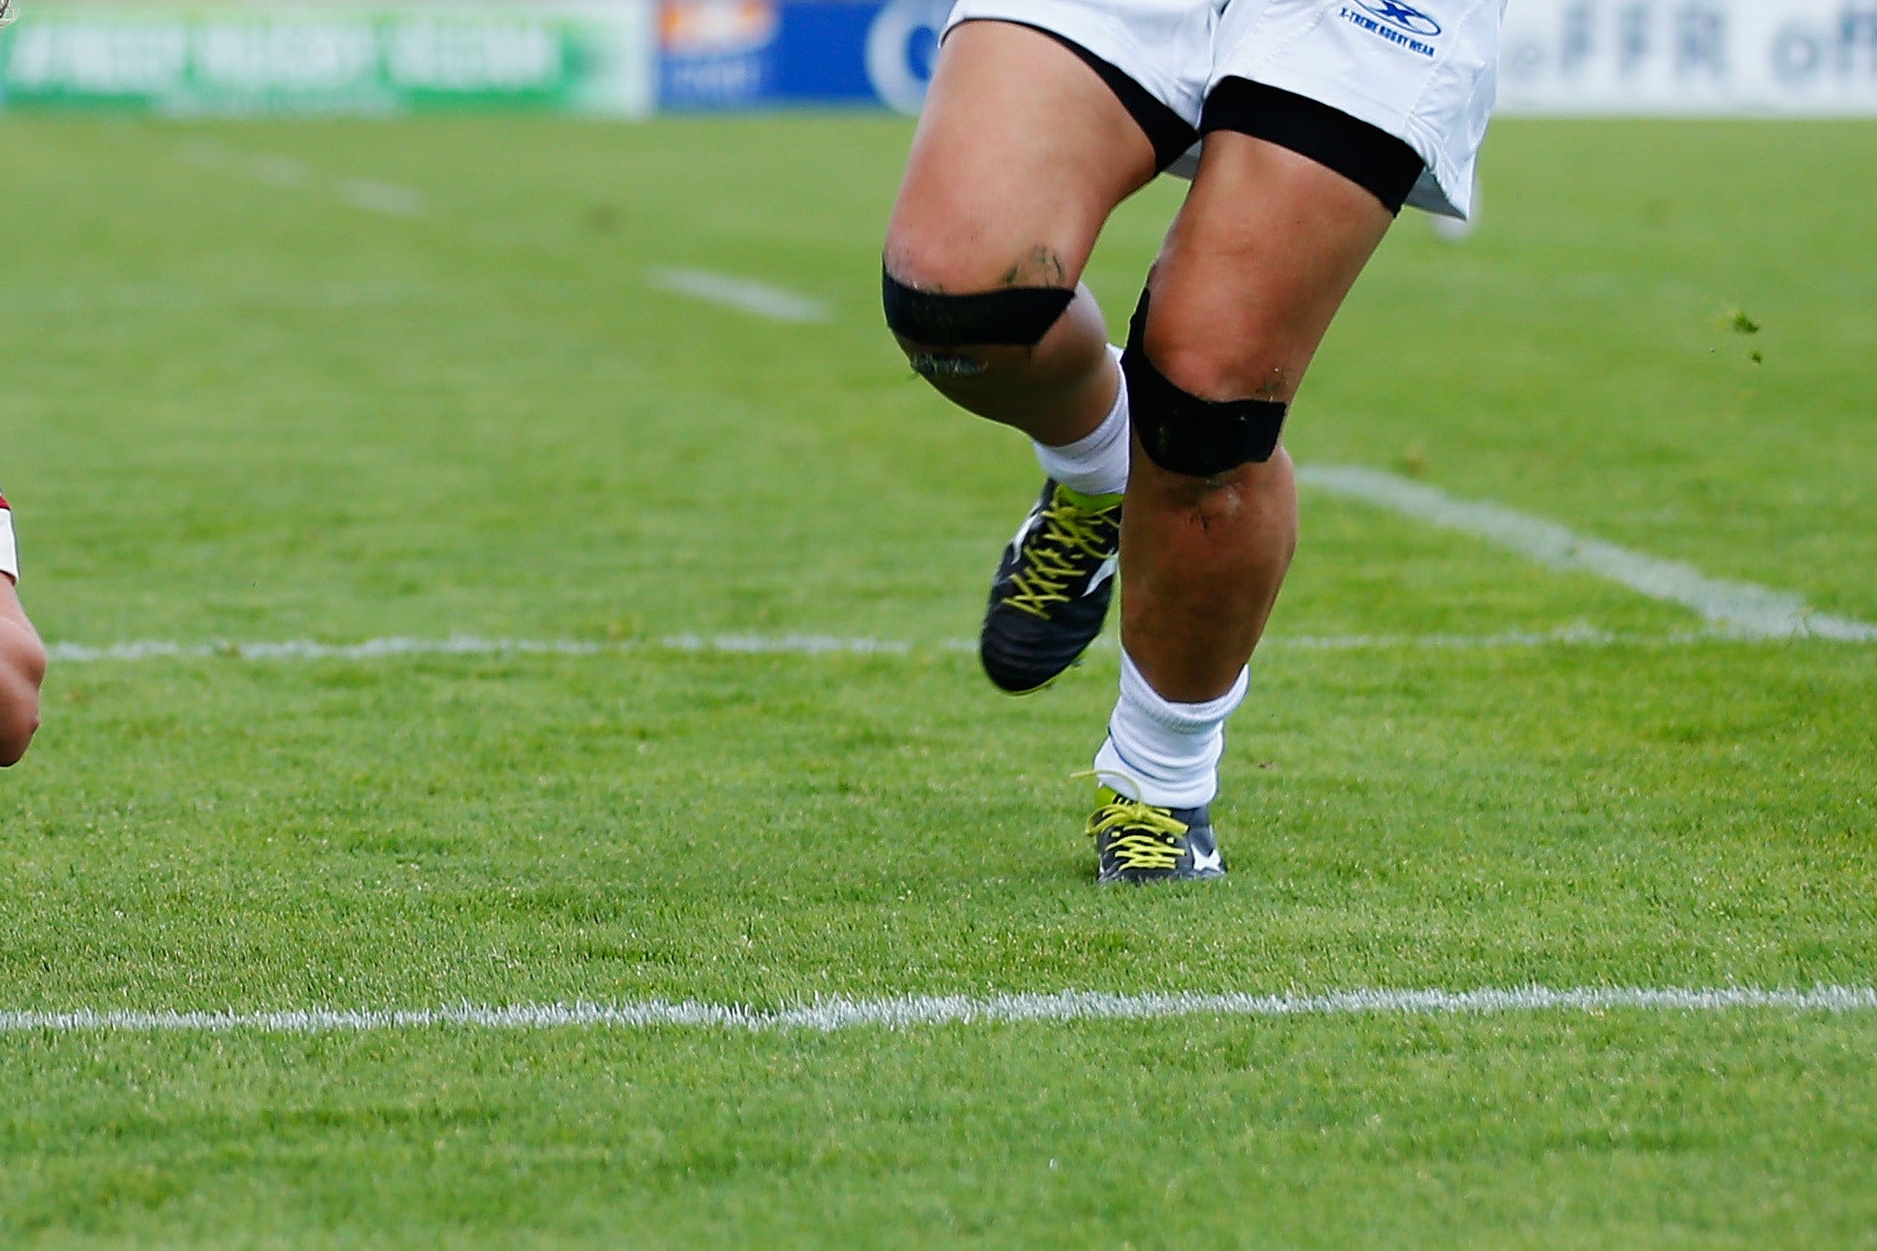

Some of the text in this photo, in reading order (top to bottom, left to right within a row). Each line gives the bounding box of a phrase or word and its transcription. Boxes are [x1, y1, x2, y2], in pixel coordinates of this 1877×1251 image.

[1340, 7, 1435, 57] X-TREME RUGBY WEAR
